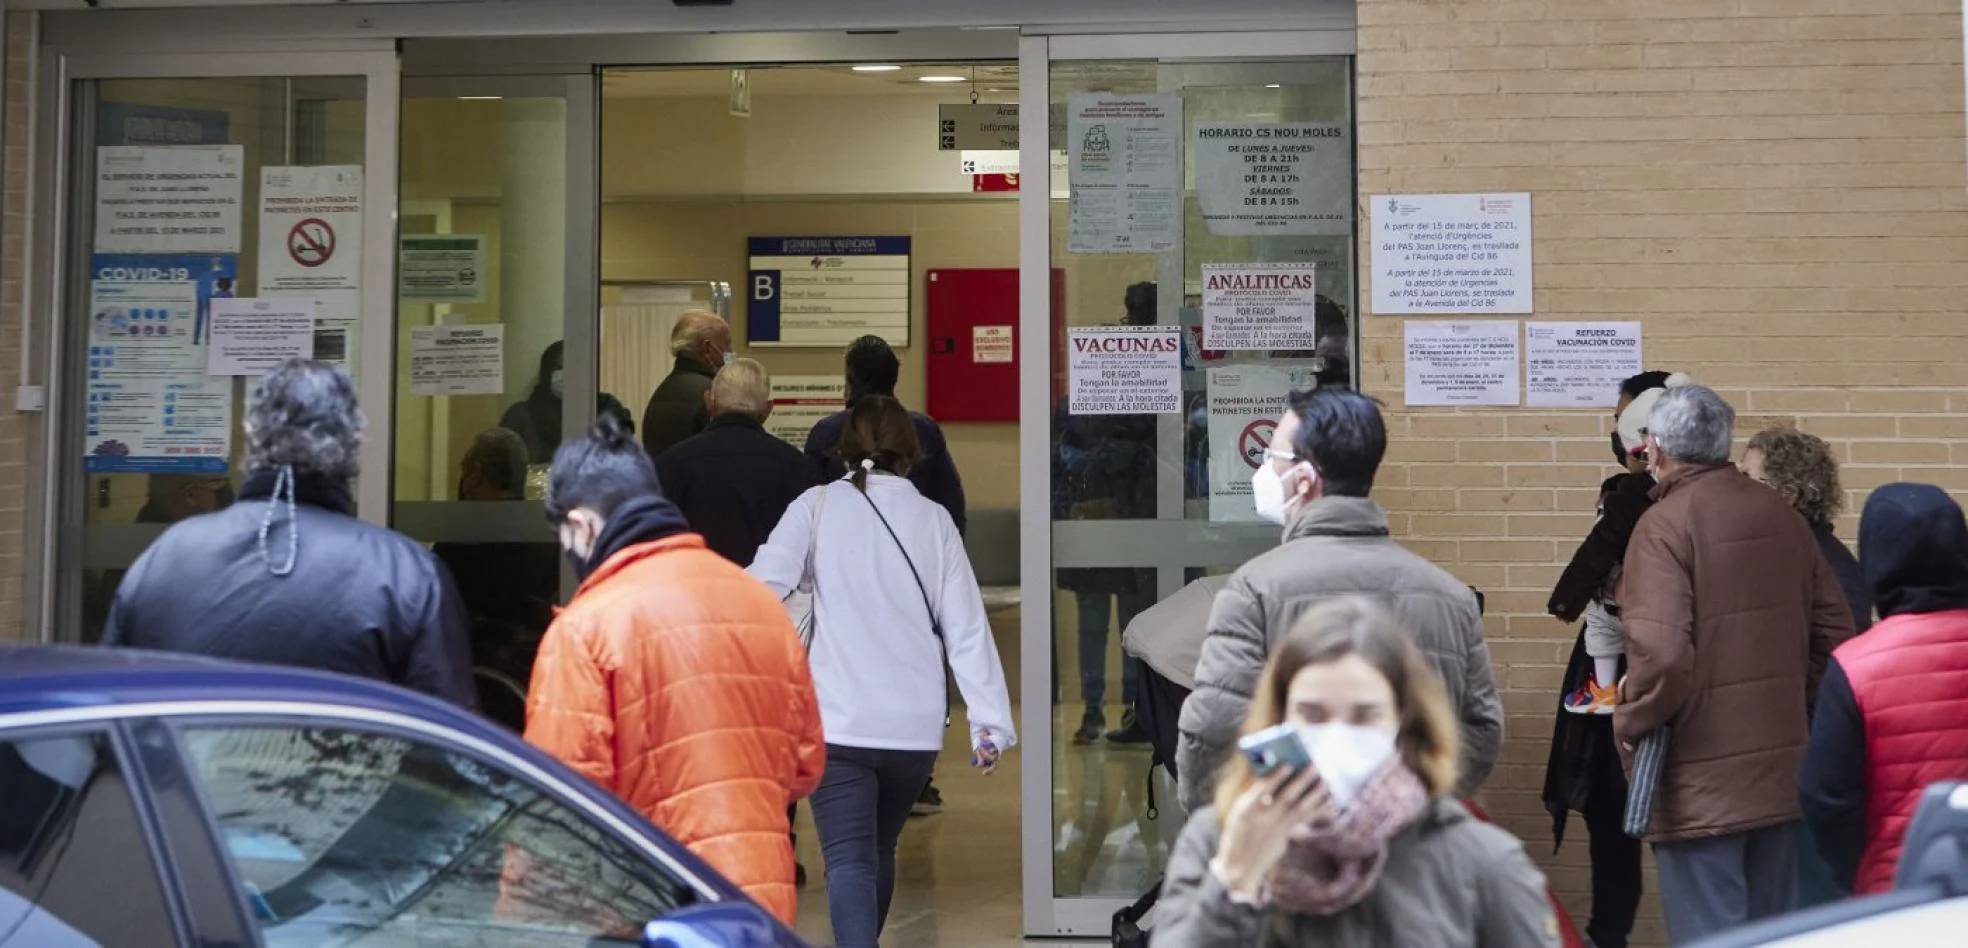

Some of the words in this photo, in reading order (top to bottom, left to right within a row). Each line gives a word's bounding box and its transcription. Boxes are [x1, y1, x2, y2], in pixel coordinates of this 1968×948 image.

[980, 123, 1020, 132] Informac
[1199, 128, 1252, 137] HORARIO
[1256, 128, 1270, 137] CS
[1274, 128, 1298, 137] NOU
[1302, 128, 1341, 137] MOLES
[1228, 145, 1240, 153] DE
[1242, 145, 1269, 153] LUNES
[1271, 145, 1278, 153] A
[1244, 155, 1257, 163] DE
[1260, 155, 1267, 163] 8
[1269, 155, 1277, 163] A
[1280, 155, 1300, 163] 21h
[1253, 165, 1290, 173] VIERNES
[1244, 175, 1257, 183] DE
[1260, 175, 1267, 183] 8
[1269, 175, 1277, 183] A
[1281, 175, 1300, 183] 17h
[1244, 198, 1257, 206] DE
[1260, 198, 1267, 206] 8
[1269, 198, 1277, 206] A
[1281, 198, 1300, 206] 15h
[1384, 222, 1390, 230] A
[1392, 222, 1414, 232] partir
[1433, 222, 1443, 230] 15
[1445, 222, 1455, 230] de
[1481, 222, 1491, 230] de
[1471, 252, 1485, 260] Cid
[98, 267, 189, 280] COVID-19
[1387, 269, 1393, 277] A
[1432, 269, 1442, 277] 15
[1443, 269, 1454, 277] de
[1207, 274, 1312, 290] ANALITICAS
[1405, 279, 1412, 287] la
[1449, 279, 1459, 287] de
[755, 275, 774, 300] B
[1471, 299, 1484, 307] Cid
[1236, 307, 1251, 315] POR
[1252, 307, 1276, 315] FAVOR
[1246, 315, 1254, 323] la
[1255, 315, 1303, 323] amabilidad
[1253, 331, 1259, 339] A
[1260, 331, 1268, 339] la
[1269, 331, 1287, 339] hora
[1288, 330, 1313, 339] citada
[1575, 329, 1616, 337] REFUERZO
[1072, 337, 1178, 353] VACUNAS
[1207, 339, 1251, 348] DISCULPEN
[1253, 339, 1267, 348] LAS
[1269, 339, 1313, 348] MOLESTIAS
[1556, 337, 1608, 346] VACUNACIÓN
[1610, 338, 1636, 346] COVID
[1101, 370, 1118, 379] POR
[1119, 370, 1141, 379] FAVOR
[1080, 379, 1110, 388] Tengan
[1111, 378, 1120, 387] la
[1121, 378, 1168, 387] amabilidad
[1118, 394, 1124, 402] A
[1126, 394, 1134, 402] la
[1135, 394, 1152, 402] hora
[1153, 394, 1178, 403] citada
[1213, 396, 1254, 405] PROHIBIDA
[1255, 396, 1264, 404] LA
[1072, 402, 1115, 411] DISCULPEN
[1117, 402, 1131, 411] LAS
[1133, 402, 1176, 411] MOLESTIAS
[1212, 406, 1252, 416] PATINETES
[1253, 406, 1263, 415] EN
